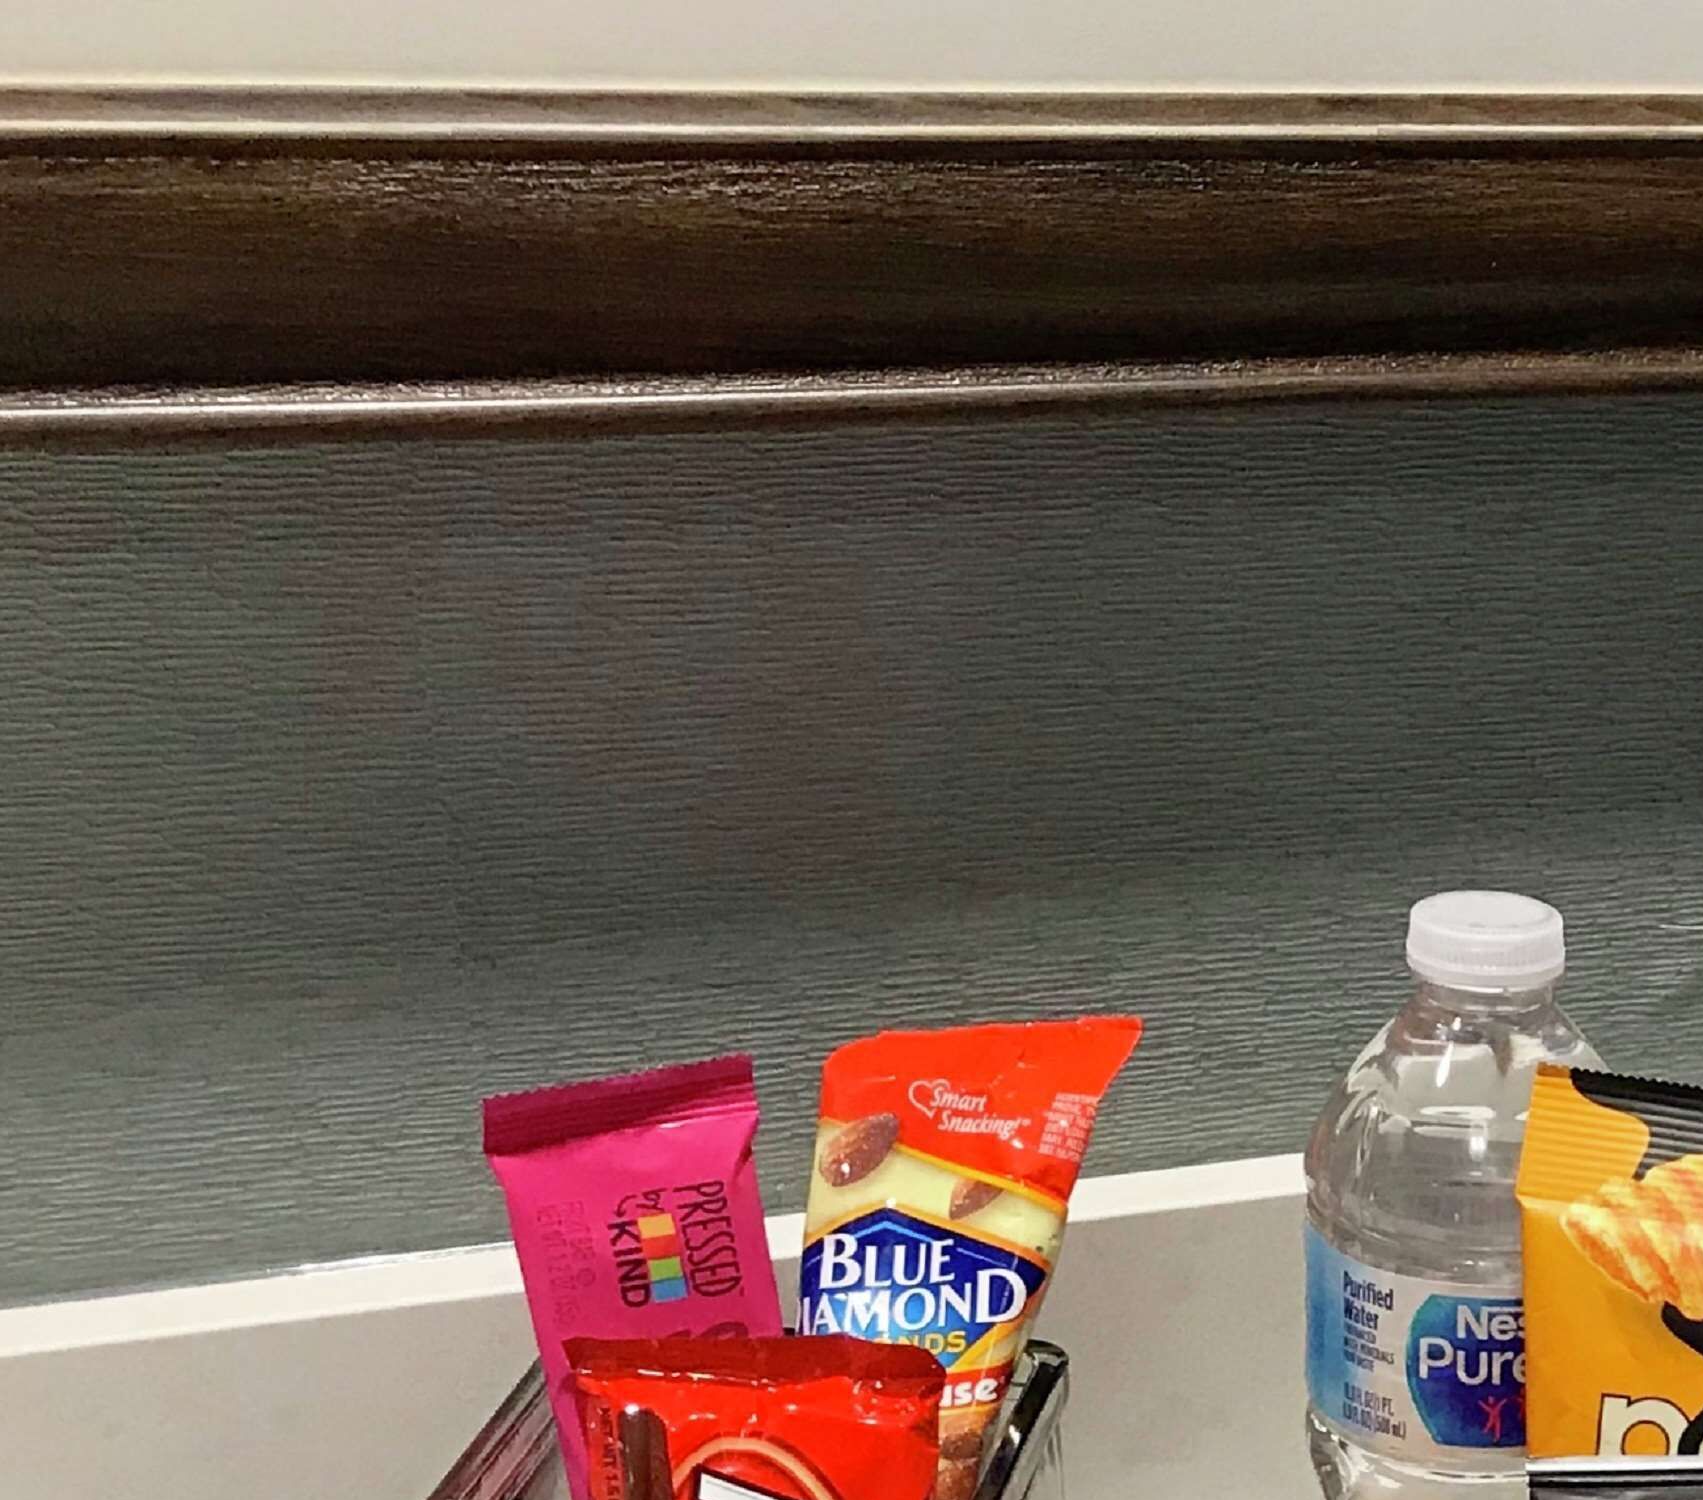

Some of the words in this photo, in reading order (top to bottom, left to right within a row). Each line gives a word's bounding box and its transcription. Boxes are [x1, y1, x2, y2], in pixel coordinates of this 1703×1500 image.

[929, 1085, 988, 1112] Smart
[937, 1109, 1020, 1141] Snacking!
[635, 1187, 667, 1214] by
[672, 1179, 743, 1297] PRESSED
[607, 1220, 651, 1308] KIND
[818, 1232, 956, 1290] BLUE
[796, 1267, 1028, 1336] IAMOND
[1342, 1270, 1394, 1311] Purified
[1342, 1298, 1380, 1331] Water
[1418, 1336, 1527, 1386] Pure
